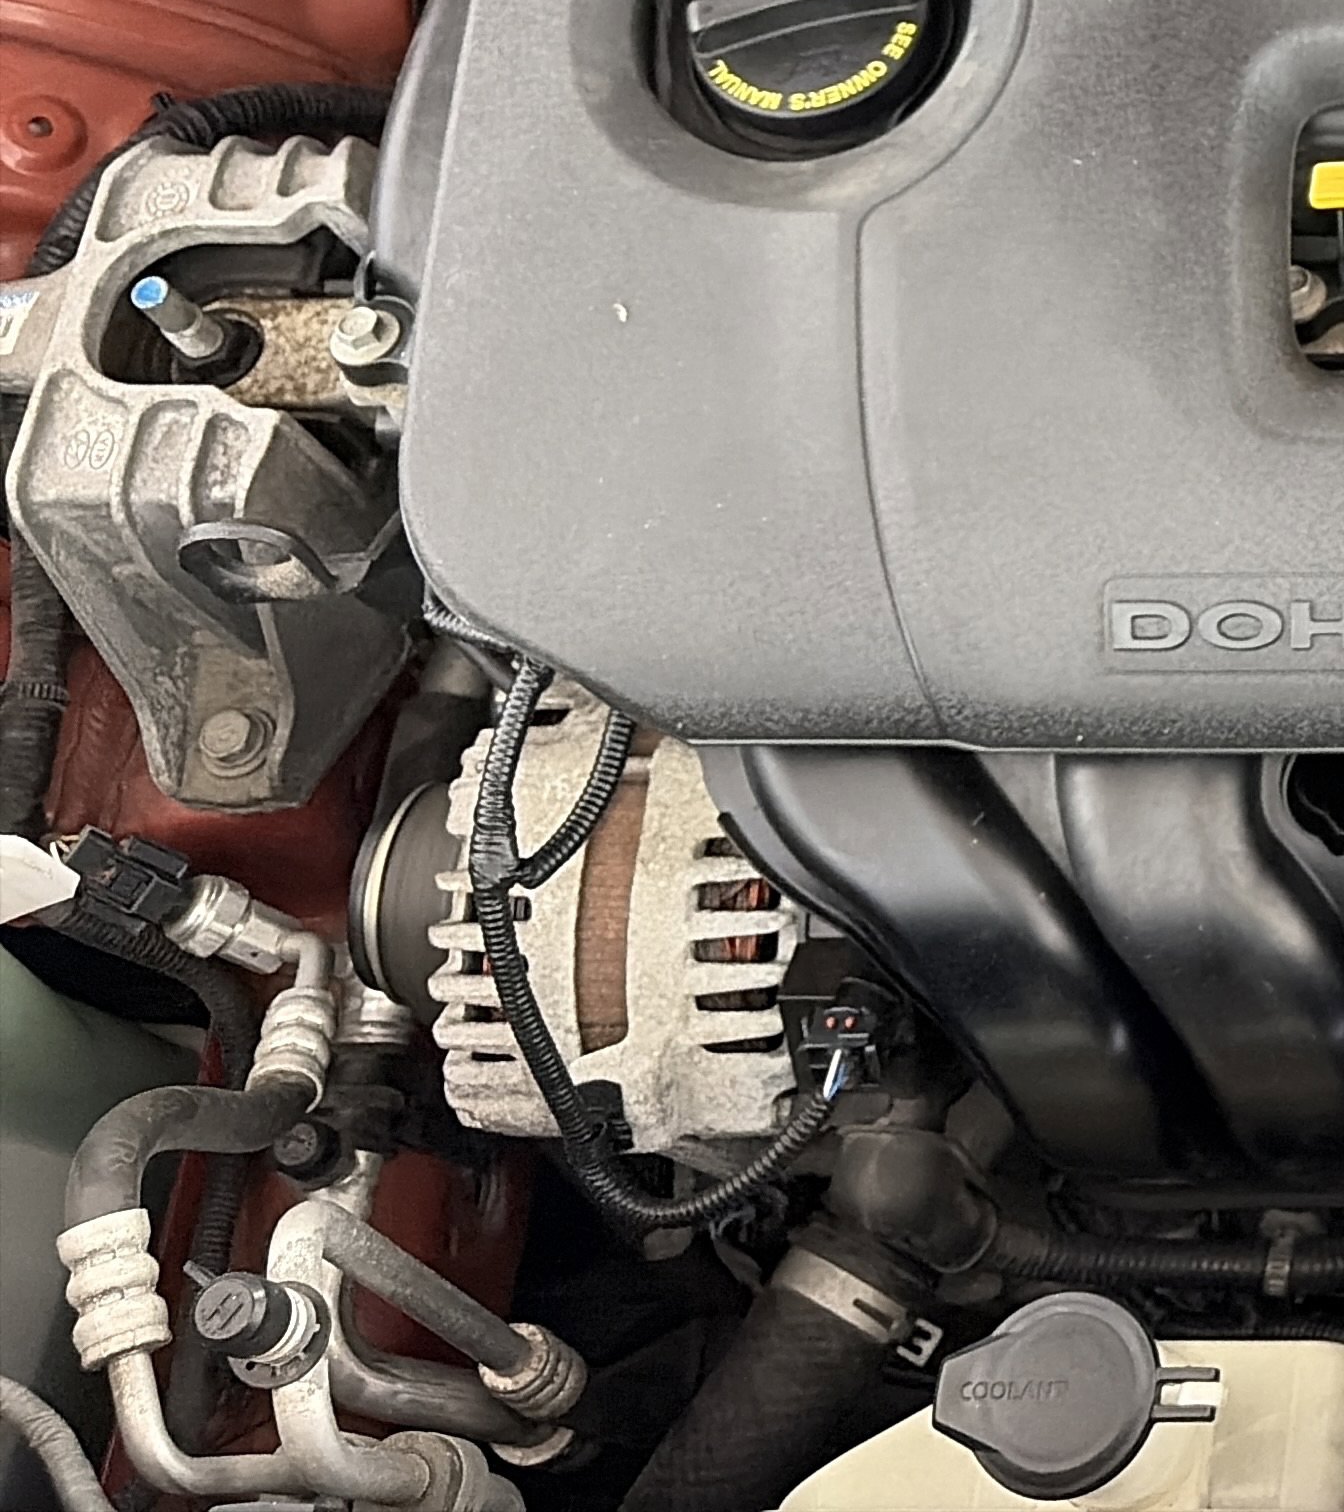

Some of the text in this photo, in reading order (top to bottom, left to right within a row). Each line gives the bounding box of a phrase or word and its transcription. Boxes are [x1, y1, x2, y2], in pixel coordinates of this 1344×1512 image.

[708, 21, 918, 112] SEE OWNER'S MANUAL
[959, 1379, 1070, 1402] COOLANT
